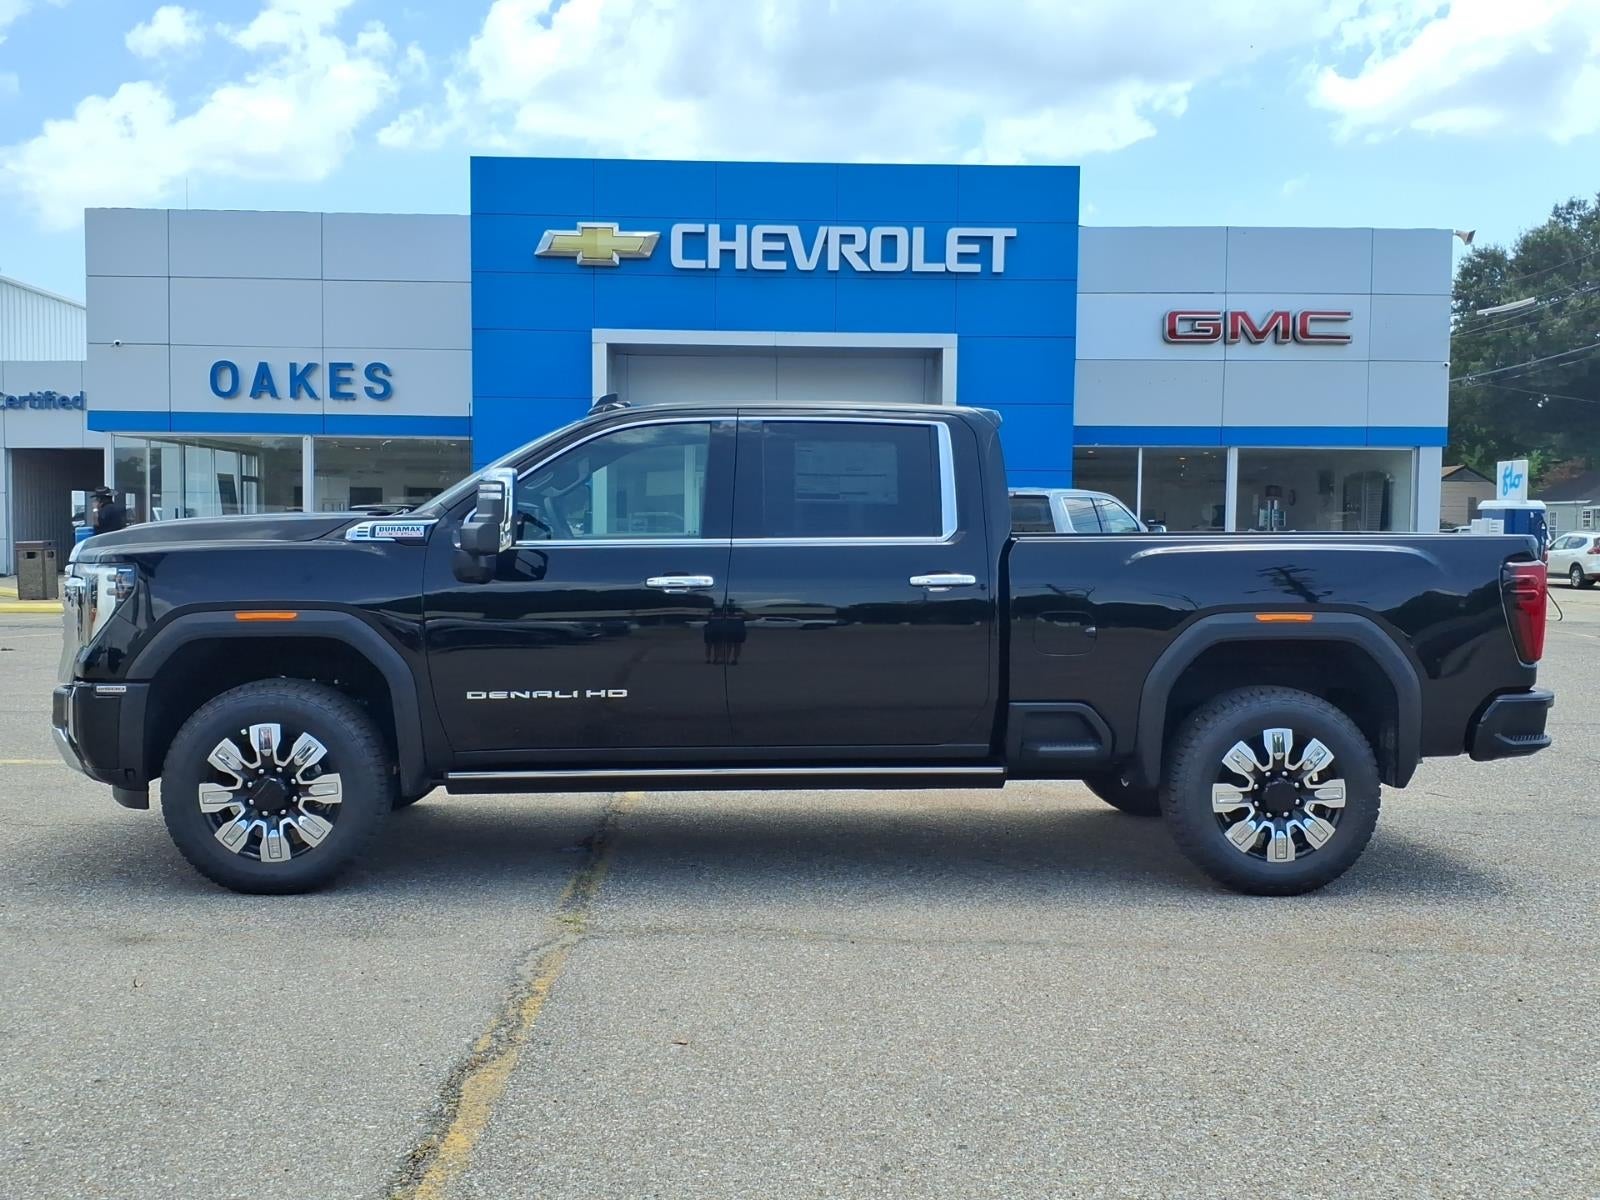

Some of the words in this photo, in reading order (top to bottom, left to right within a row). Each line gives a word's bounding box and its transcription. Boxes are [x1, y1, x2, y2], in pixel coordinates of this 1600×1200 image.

[670, 223, 1017, 274] CHEVROLET
[1163, 311, 1353, 344] GMC
[209, 359, 393, 401] OAKES
[466, 690, 579, 700] DENALI
[585, 689, 628, 698] HD
